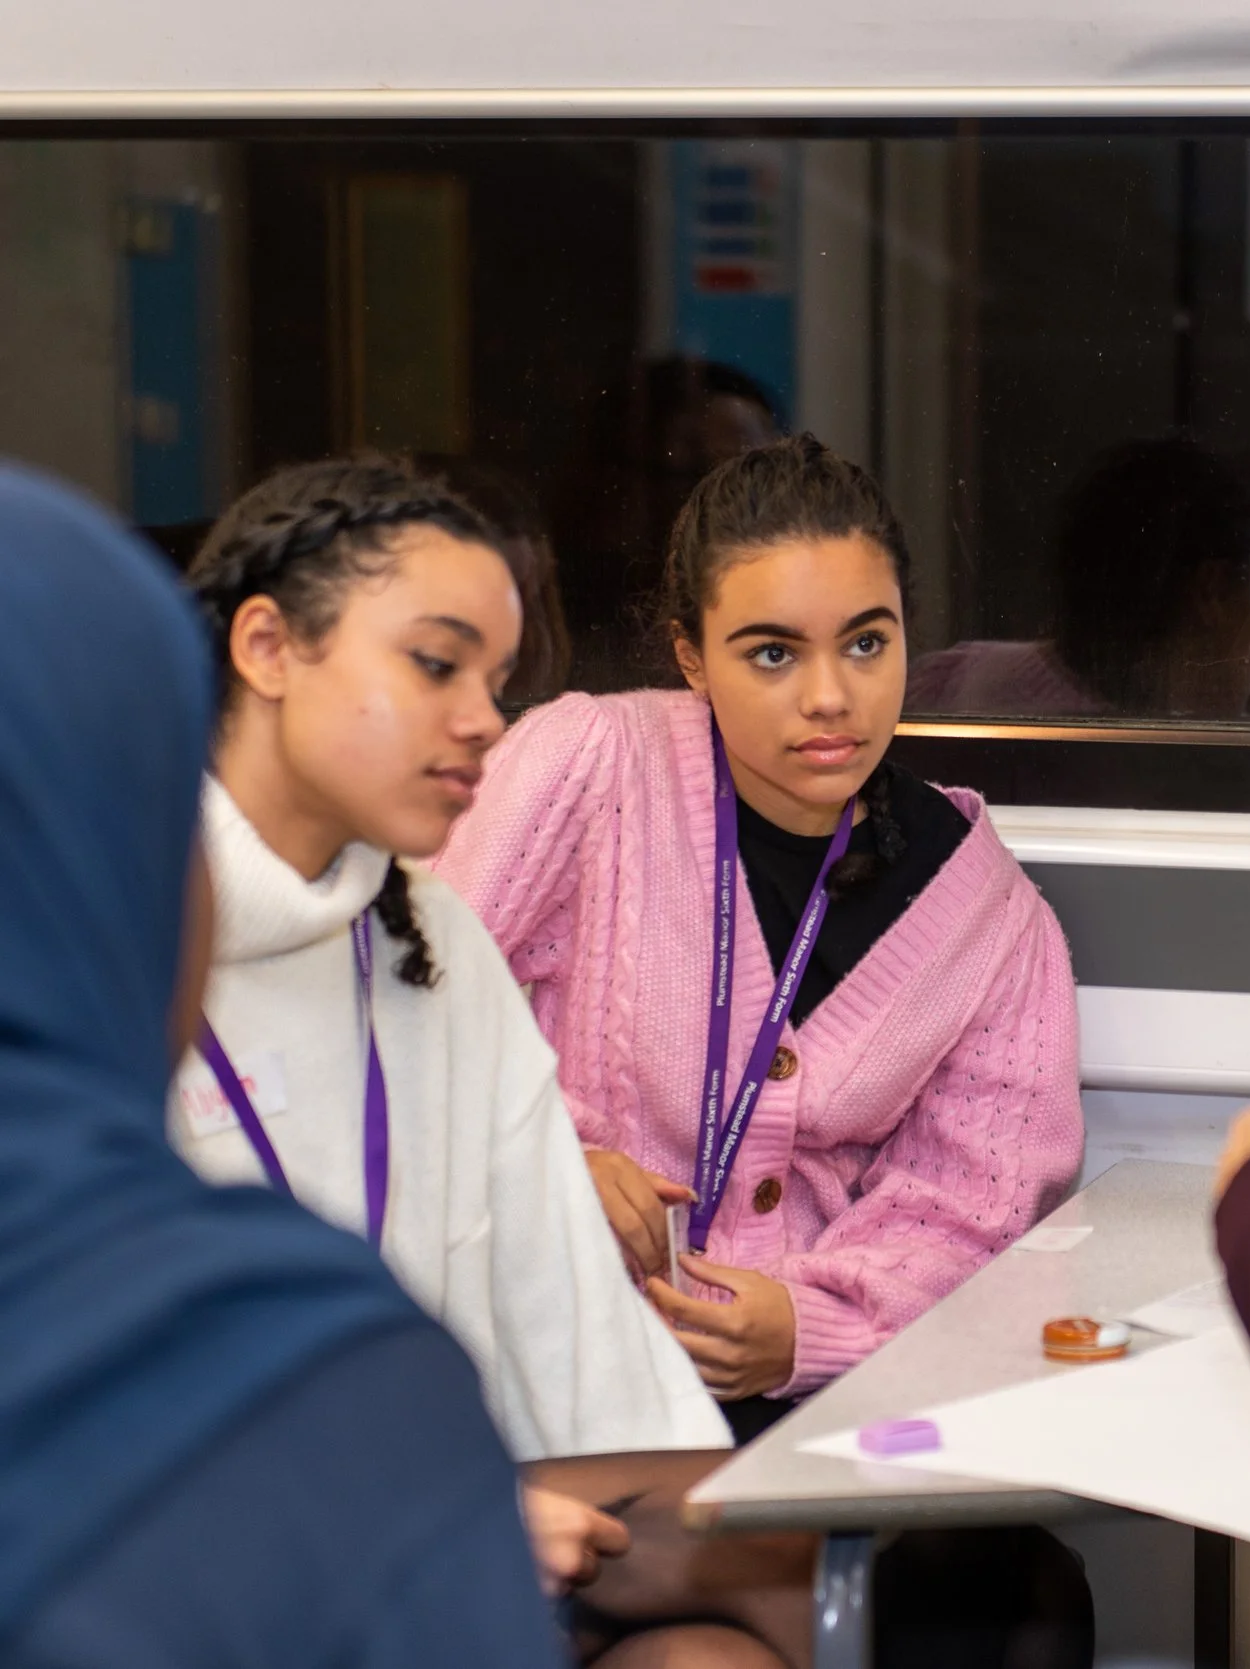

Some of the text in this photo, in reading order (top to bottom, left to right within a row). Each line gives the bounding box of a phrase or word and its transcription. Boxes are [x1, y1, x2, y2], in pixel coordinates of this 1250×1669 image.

[716, 860, 731, 1007] Plumstead Manor Sixth Form
[790, 938, 809, 971] Manor
[780, 972, 796, 996] Sixth
[770, 998, 787, 1023] Form
[710, 1069, 721, 1096] Form
[706, 1097, 717, 1124] Sixth
[730, 1081, 757, 1133] Plumstead
[703, 1126, 715, 1161] Manor
[718, 1133, 737, 1168] Manor
